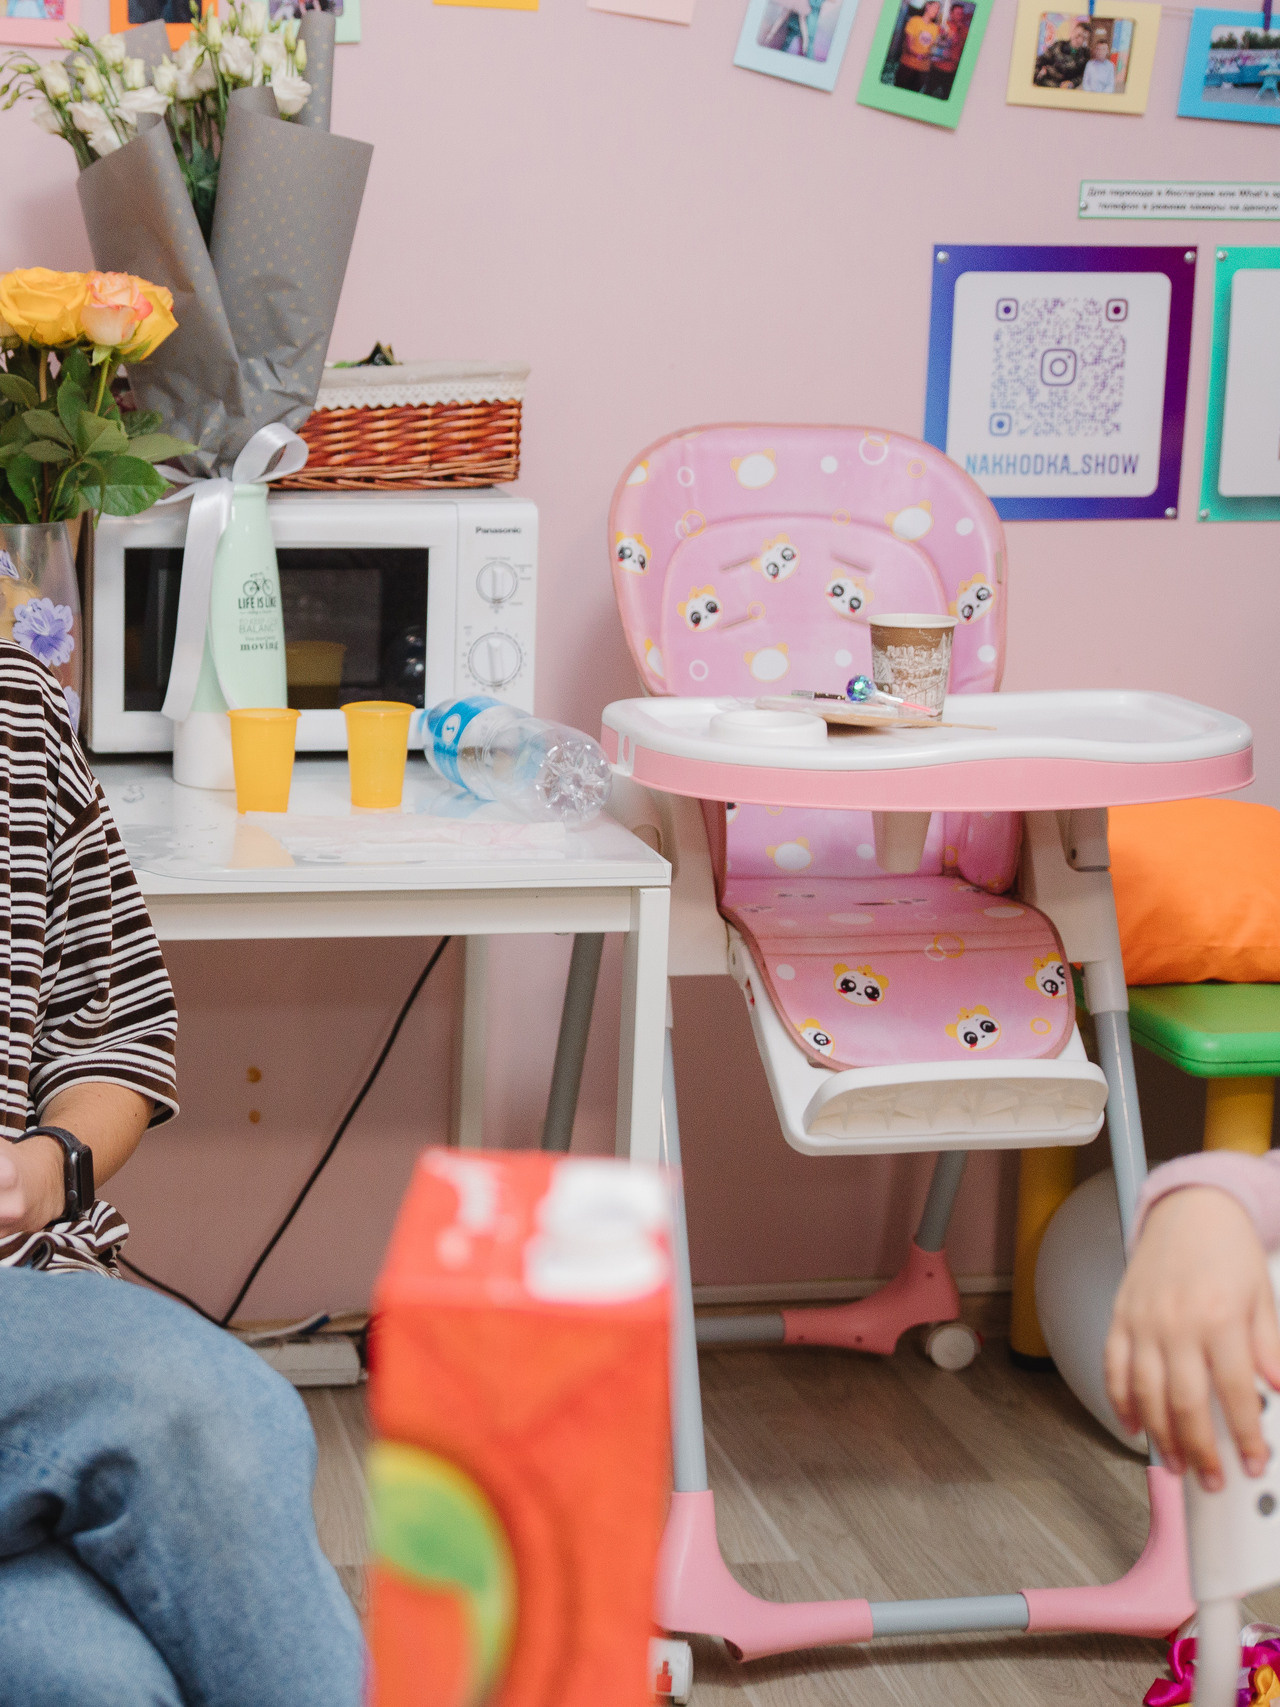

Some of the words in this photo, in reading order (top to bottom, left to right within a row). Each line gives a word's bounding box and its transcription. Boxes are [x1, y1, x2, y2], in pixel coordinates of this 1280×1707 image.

[966, 454, 1139, 475] NAKHODKA_SHOW
[475, 526, 522, 535] Panasonic
[238, 597, 254, 609] LIFE
[257, 597, 264, 608] IS
